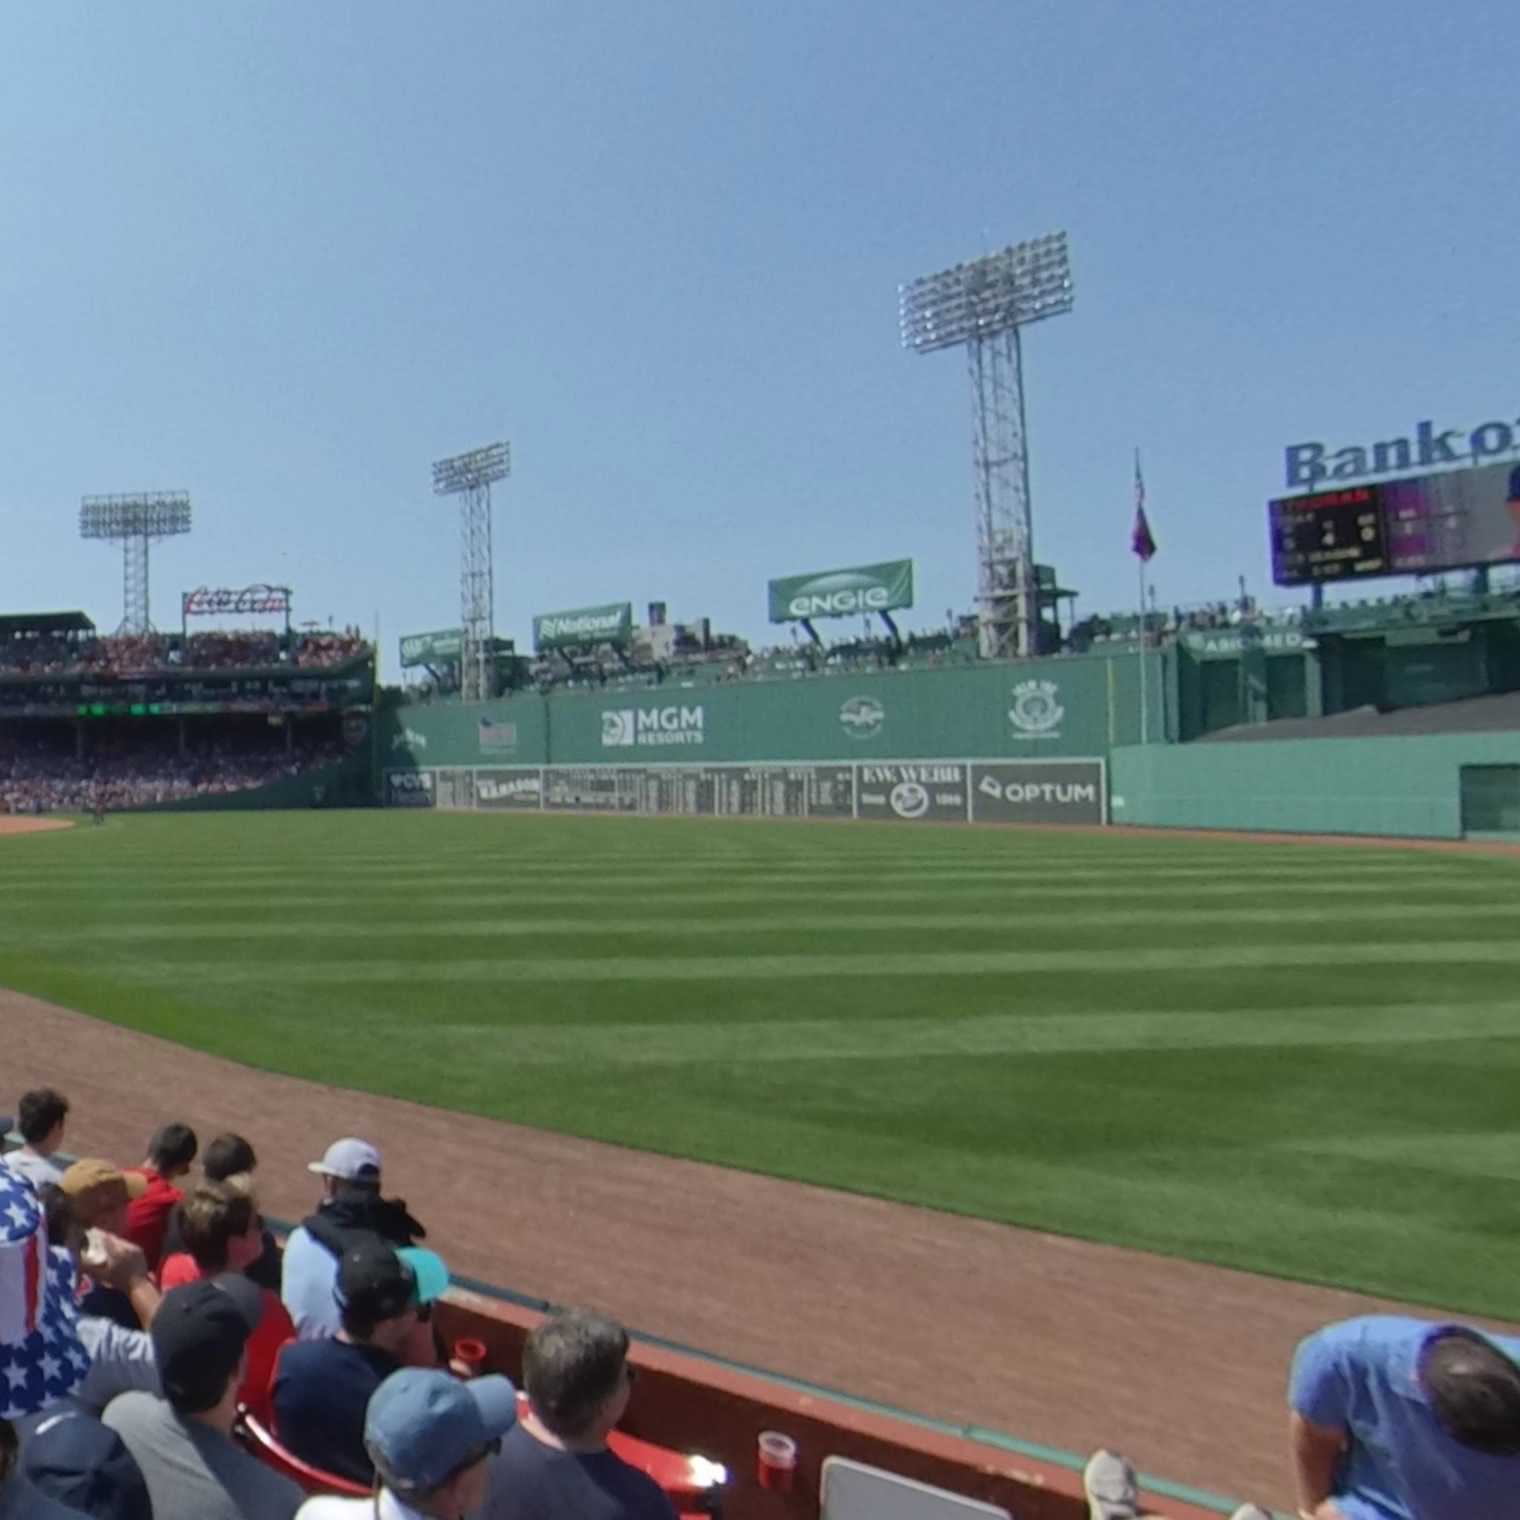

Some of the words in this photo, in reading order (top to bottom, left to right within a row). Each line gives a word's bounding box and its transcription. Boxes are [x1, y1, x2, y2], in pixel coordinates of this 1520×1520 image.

[1285, 420, 1466, 487] Bank
[1470, 418, 1520, 455] o
[637, 706, 703, 731] MGM
[637, 730, 704, 745] RESORTS
[1005, 783, 1096, 803] OPTUM
